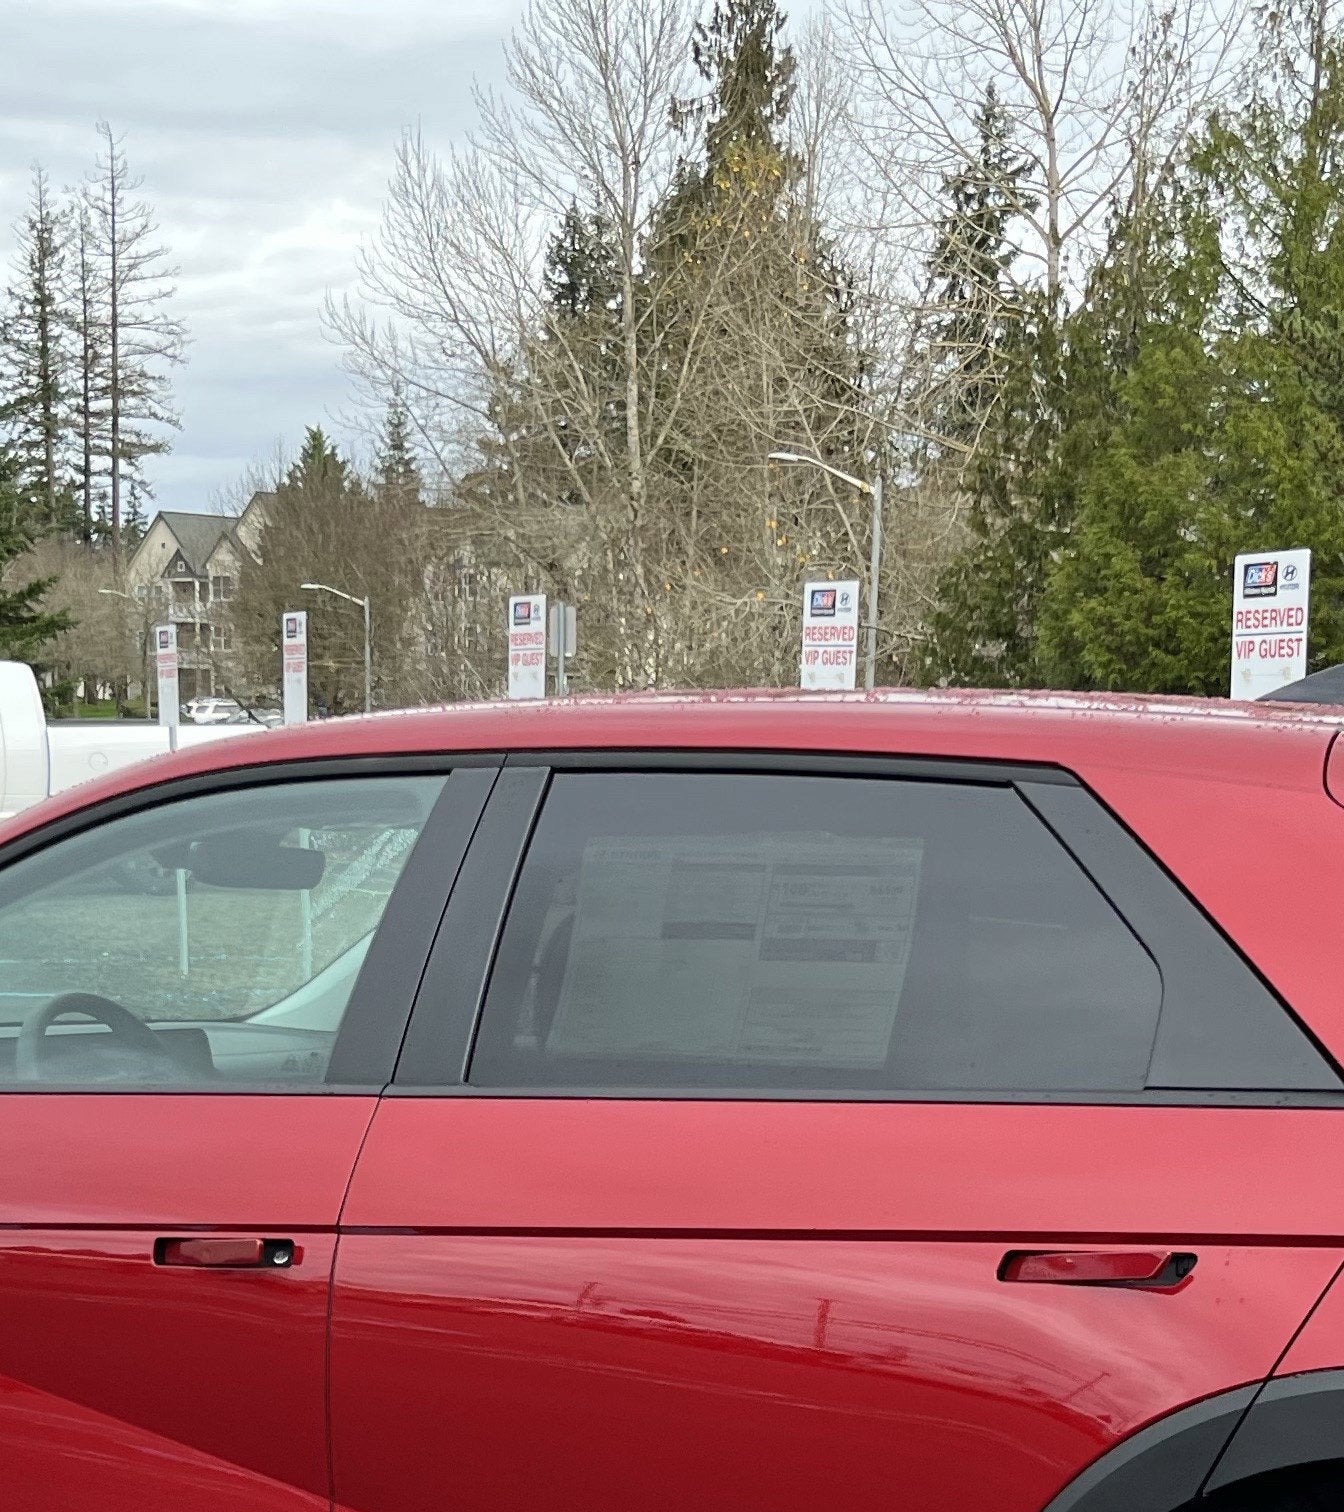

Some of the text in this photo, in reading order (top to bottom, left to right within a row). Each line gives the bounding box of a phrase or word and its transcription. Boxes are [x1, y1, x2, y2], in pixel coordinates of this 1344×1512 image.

[1236, 607, 1304, 630] RESERVED
[804, 626, 854, 642] RESERVED
[805, 650, 854, 667] VIP GUEST
[1236, 638, 1303, 660] VIP GUEST
